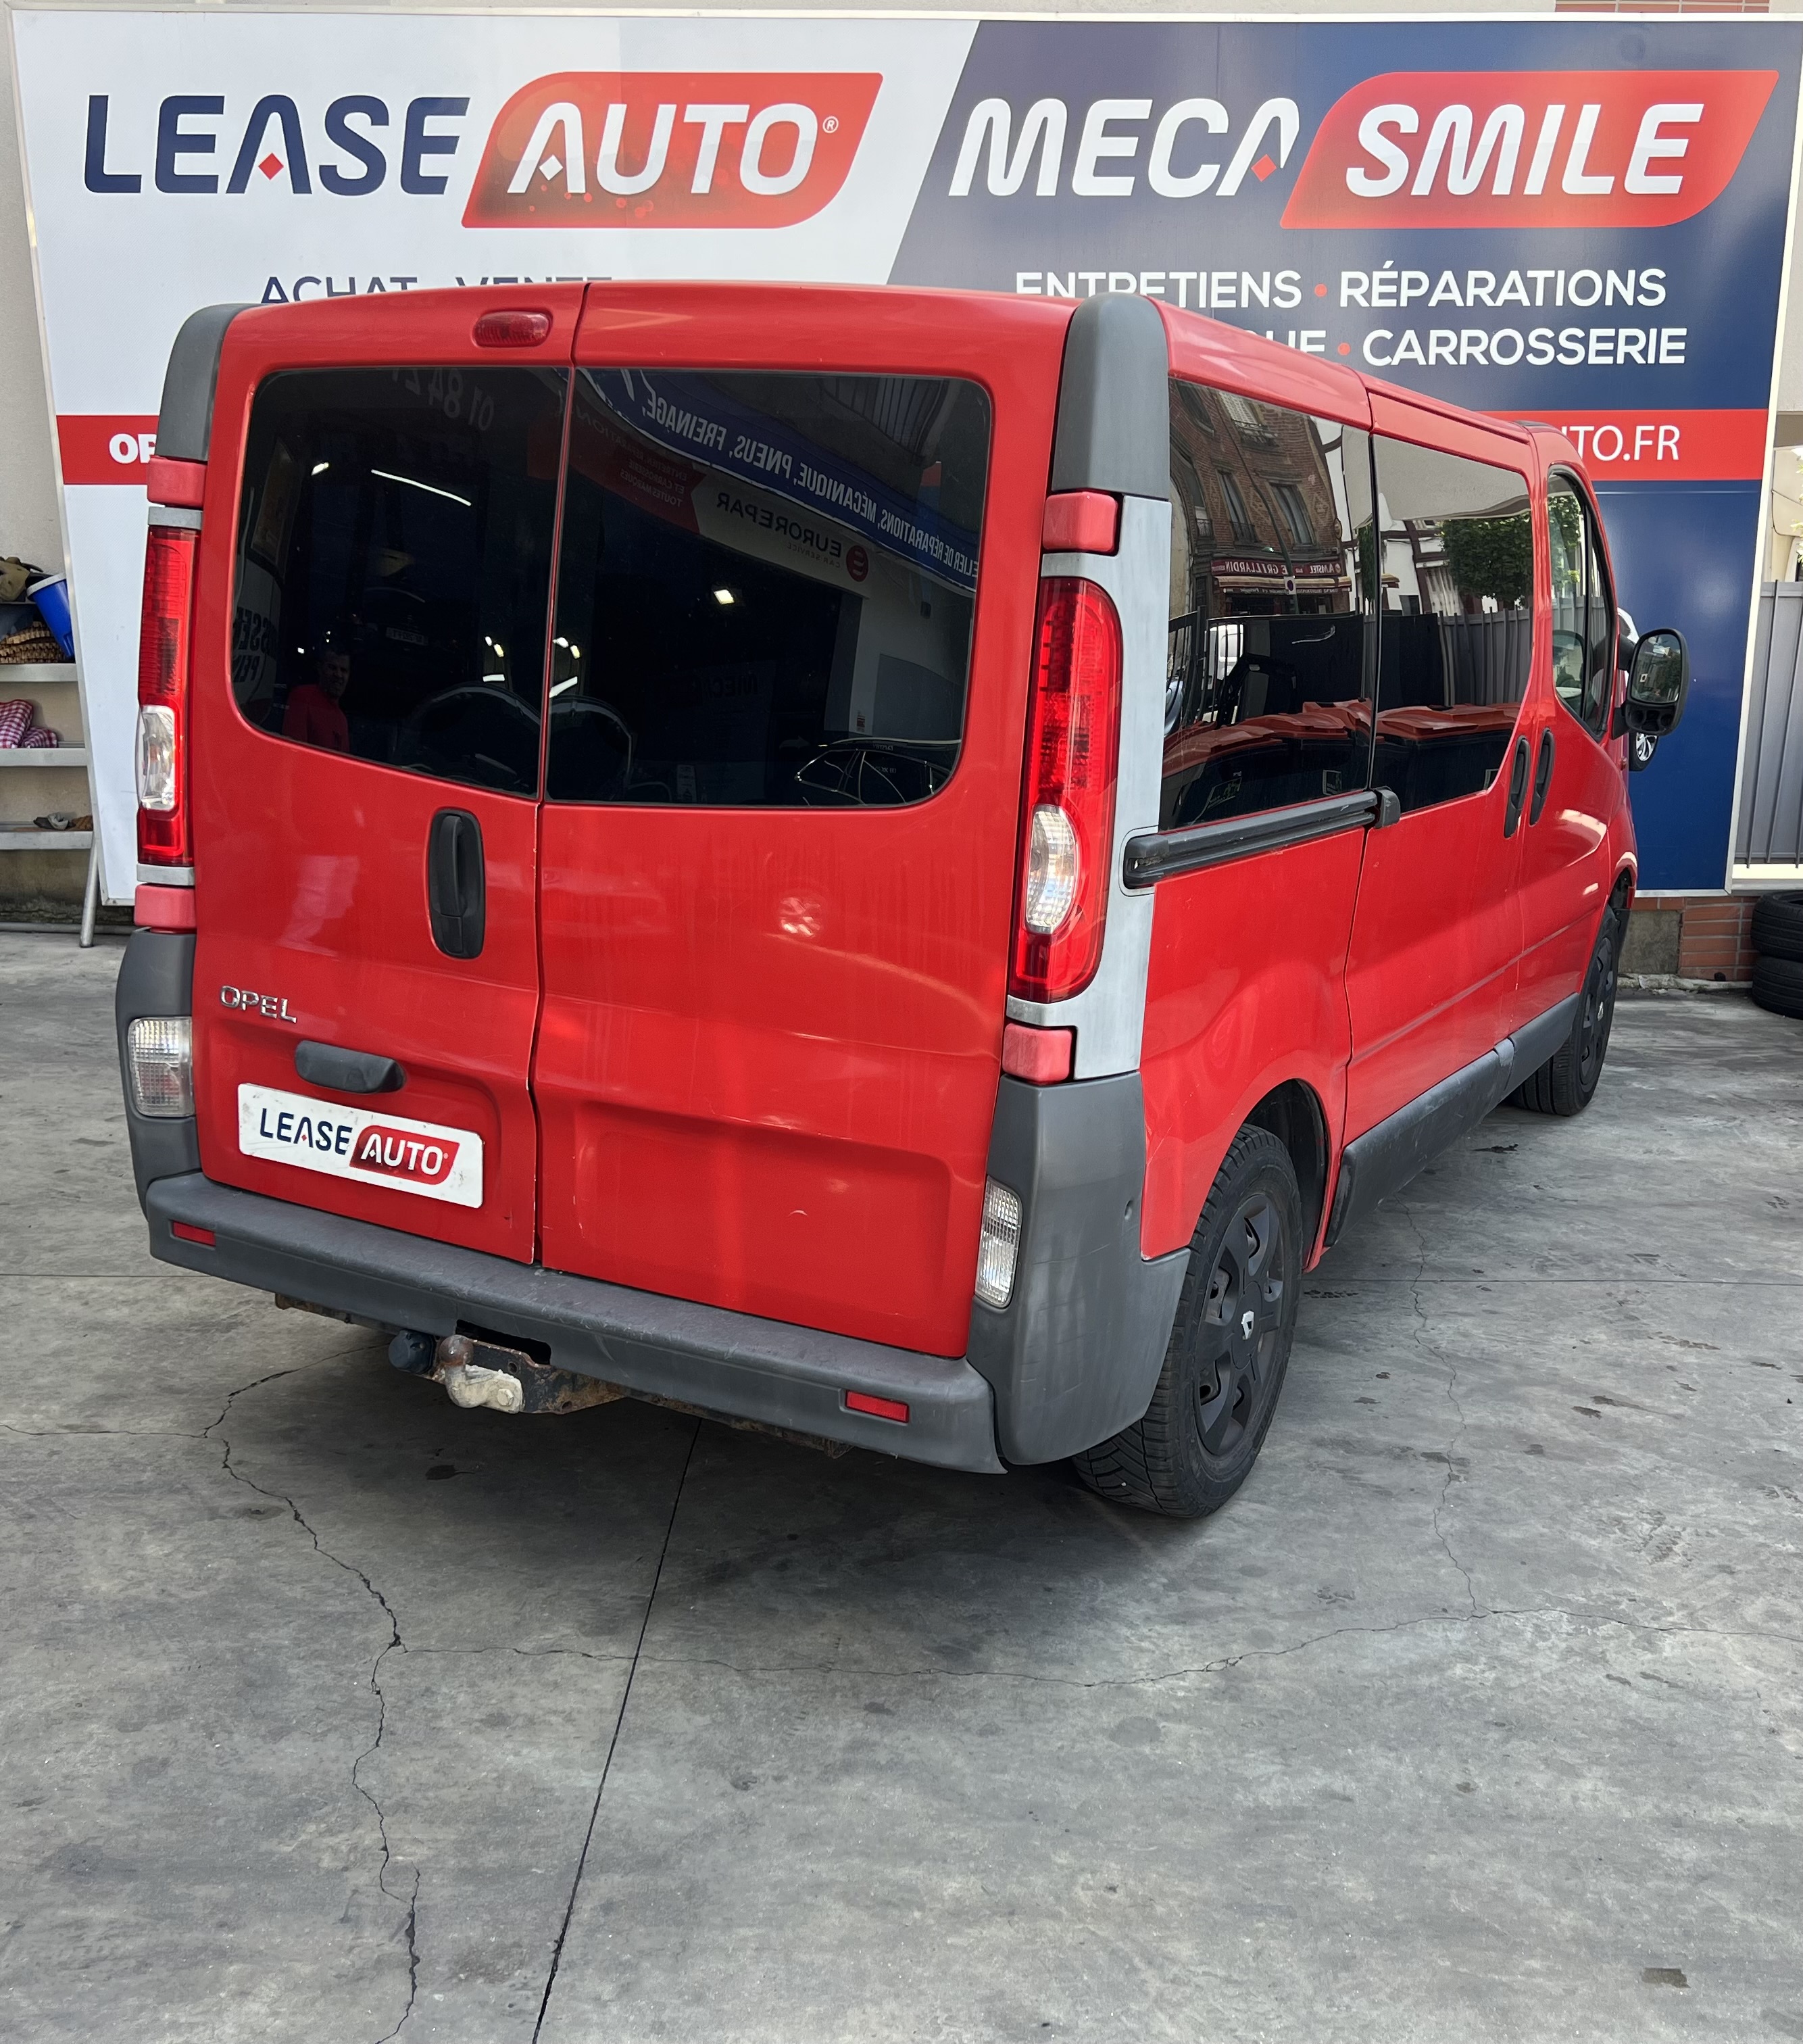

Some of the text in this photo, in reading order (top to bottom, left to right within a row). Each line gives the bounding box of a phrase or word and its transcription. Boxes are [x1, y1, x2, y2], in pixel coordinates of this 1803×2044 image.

[84, 95, 470, 195] LEASE
[948, 98, 1704, 197] MECA SMILE
[1016, 261, 1666, 308] ENTRETIENS RÉPARATIONS
[1363, 327, 1687, 366] CARROSSERIE
[1562, 425, 1680, 461] TO.FR
[220, 985, 297, 1024] OPEL
[259, 1108, 353, 1155] LEASE
